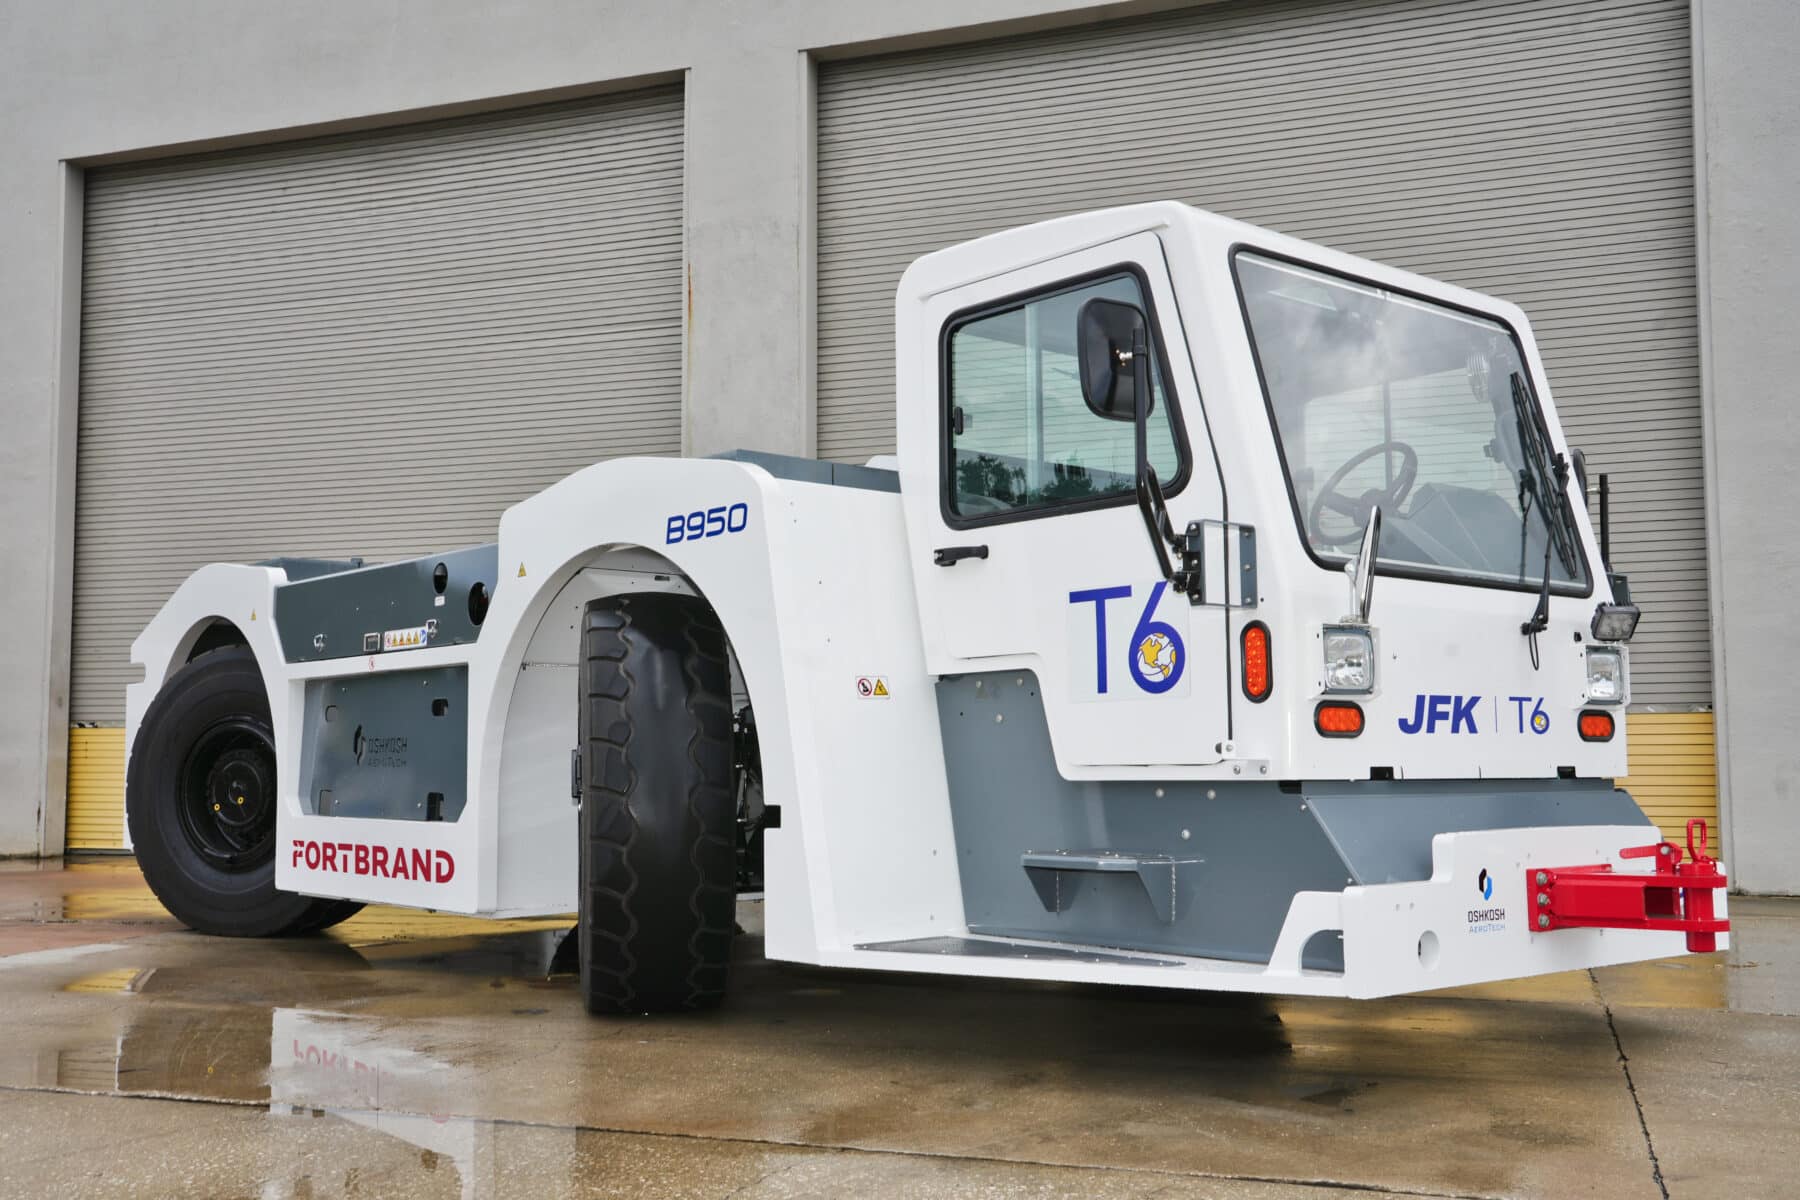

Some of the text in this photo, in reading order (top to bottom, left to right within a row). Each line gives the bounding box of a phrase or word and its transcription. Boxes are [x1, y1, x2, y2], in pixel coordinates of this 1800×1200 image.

[666, 502, 748, 545] B950
[1069, 580, 1186, 694] T6
[1398, 694, 1550, 735] JFK T6
[292, 839, 455, 883] FORTBRAND
[1467, 908, 1505, 923] OSHKOSH
